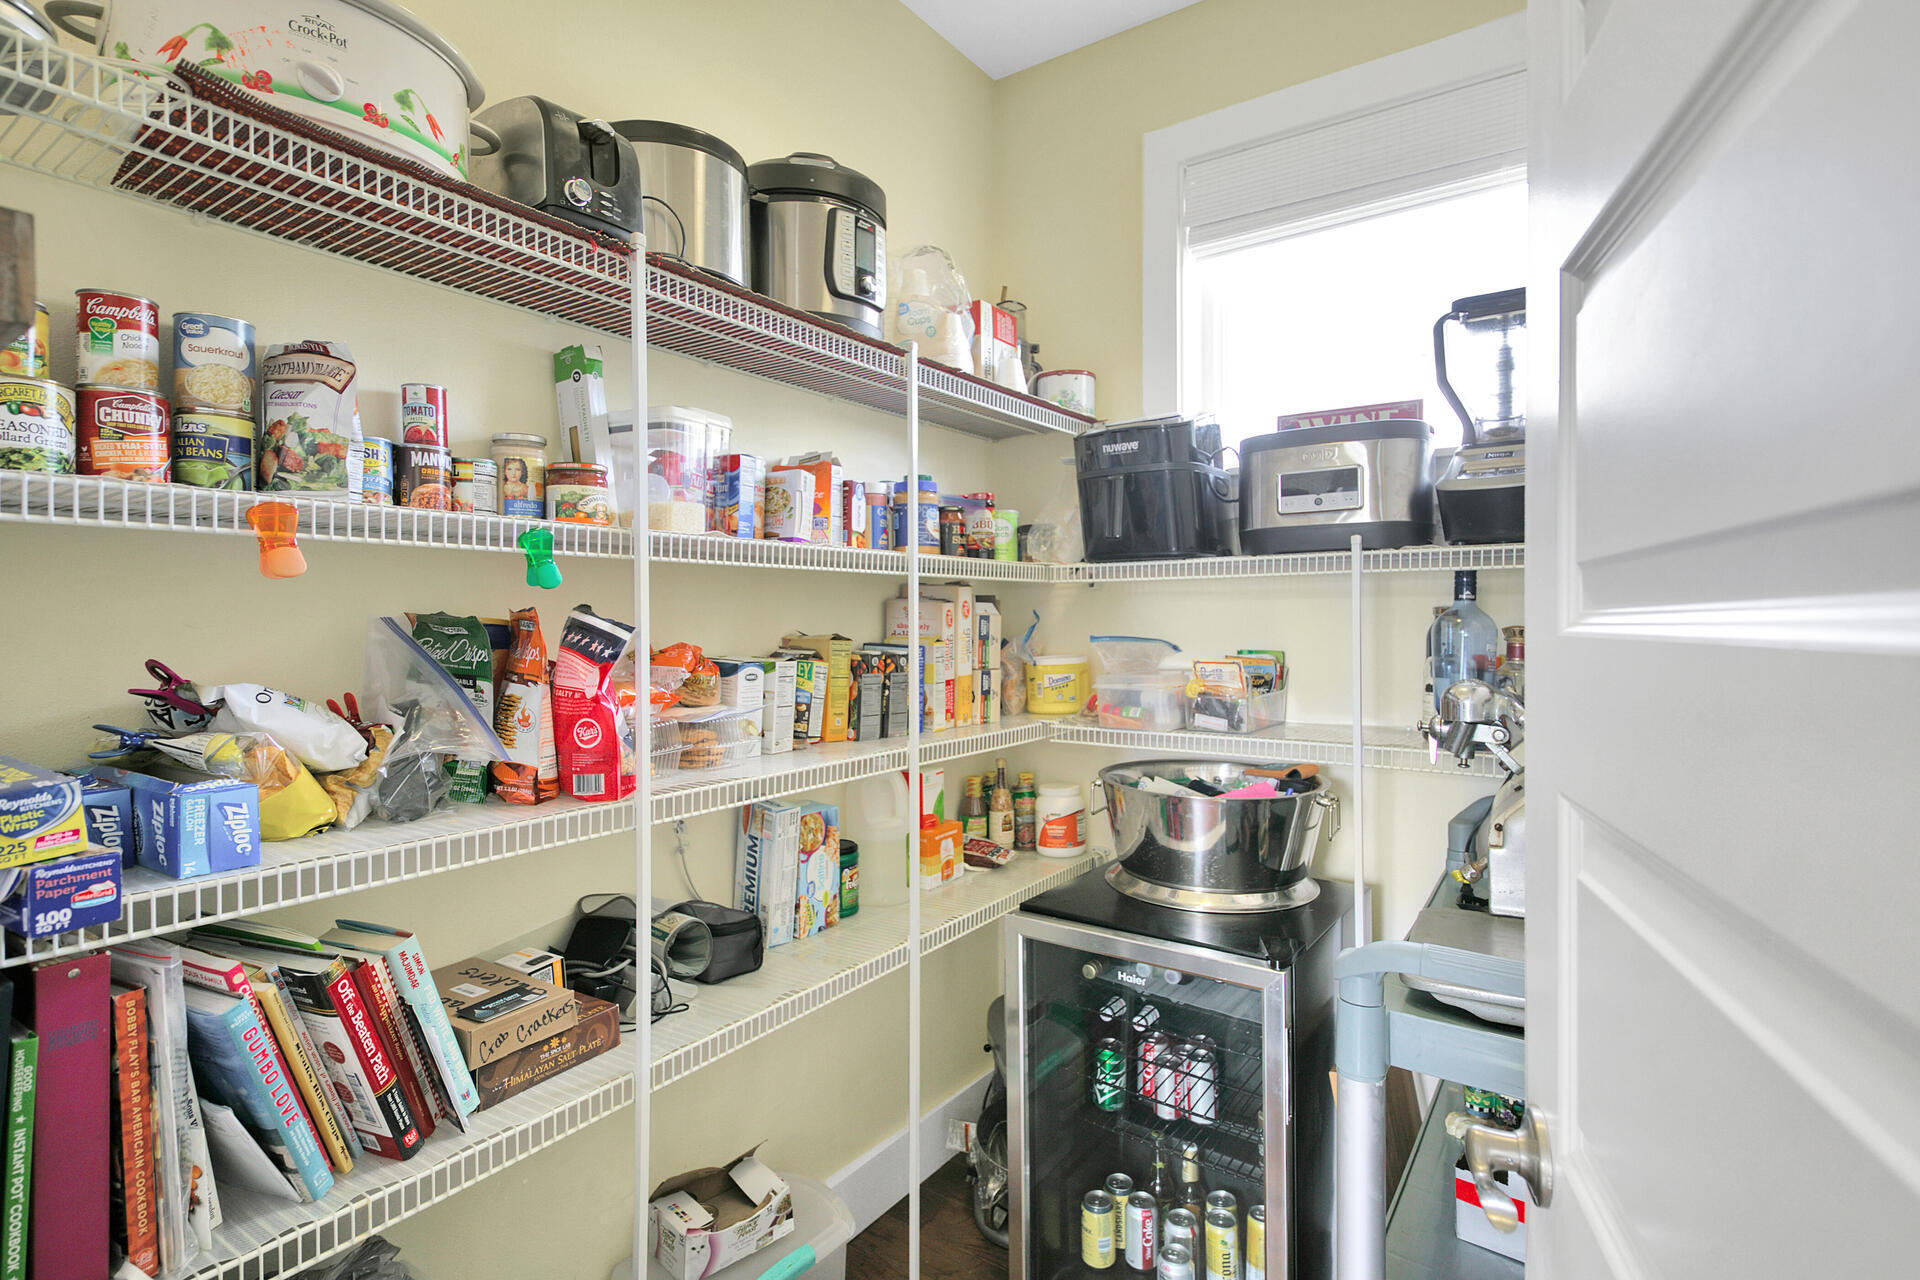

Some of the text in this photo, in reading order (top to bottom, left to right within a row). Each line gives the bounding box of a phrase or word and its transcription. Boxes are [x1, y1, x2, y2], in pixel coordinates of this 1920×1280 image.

[187, 343, 244, 360] Sauerkraut
[403, 405, 434, 418] TOMATO
[186, 446, 224, 460] BEANS
[364, 447, 388, 463] SH'S
[1102, 440, 1140, 453] nuwave
[0, 809, 46, 823] Plastic
[0, 819, 38, 833] Wrap
[90, 804, 124, 849] Ziplo
[185, 799, 194, 831] GALLON
[194, 798, 206, 846] FREEZER
[223, 802, 253, 856] Ziploc
[152, 799, 167, 867] Ziploc
[35, 867, 113, 889] Parchment
[183, 861, 196, 875] 14
[743, 834, 759, 914] REMIUM
[35, 885, 78, 899] Paper
[35, 908, 72, 928] 100
[55, 920, 71, 930] FT
[398, 950, 420, 990] MAJUMDAR
[411, 952, 425, 976] SIMON
[1117, 971, 1146, 986] Haier
[125, 999, 137, 1038] BOBBY
[337, 979, 389, 1086] Off the Beaten Path
[376, 1002, 400, 1043] Appetizer
[479, 1031, 509, 1064] Crab
[516, 998, 576, 1044] Crackers
[127, 1040, 139, 1078] FLAY'S
[503, 1037, 602, 1090] HIMALAYAN SALT PLATE
[12, 1048, 26, 1113] HOUSEKEEPING
[23, 1065, 33, 1093] GOOD
[130, 1080, 142, 1104] BAR
[242, 1026, 279, 1085] GUMBO
[271, 1082, 300, 1128] LOVE
[312, 1081, 326, 1111] Ribs,
[325, 1111, 340, 1142] Chops
[7, 1127, 27, 1274] INSTANT POT COOKBOOK
[135, 1170, 149, 1237] COOKBOOK
[1142, 1218, 1153, 1248] Coke
